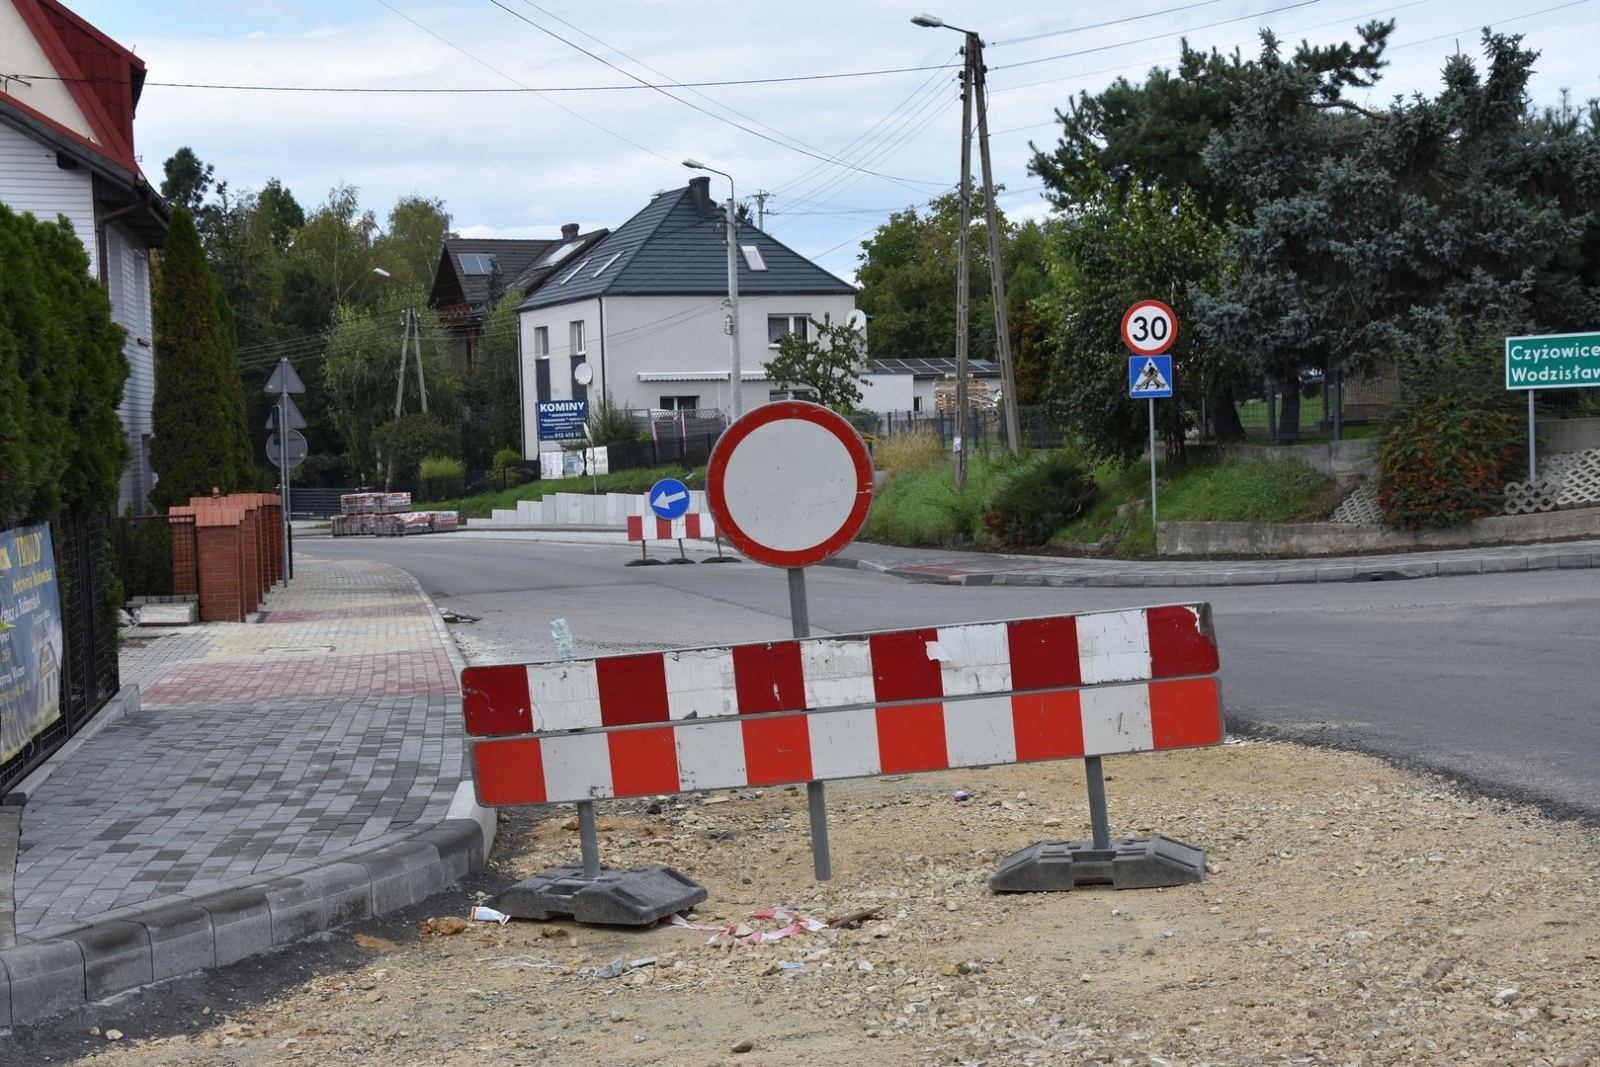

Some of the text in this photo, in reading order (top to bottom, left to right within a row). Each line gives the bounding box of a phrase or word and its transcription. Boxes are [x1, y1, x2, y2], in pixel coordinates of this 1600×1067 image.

[1132, 315, 1168, 342] 30
[1510, 342, 1600, 364] Czyżowice
[540, 402, 584, 412] KOMINY
